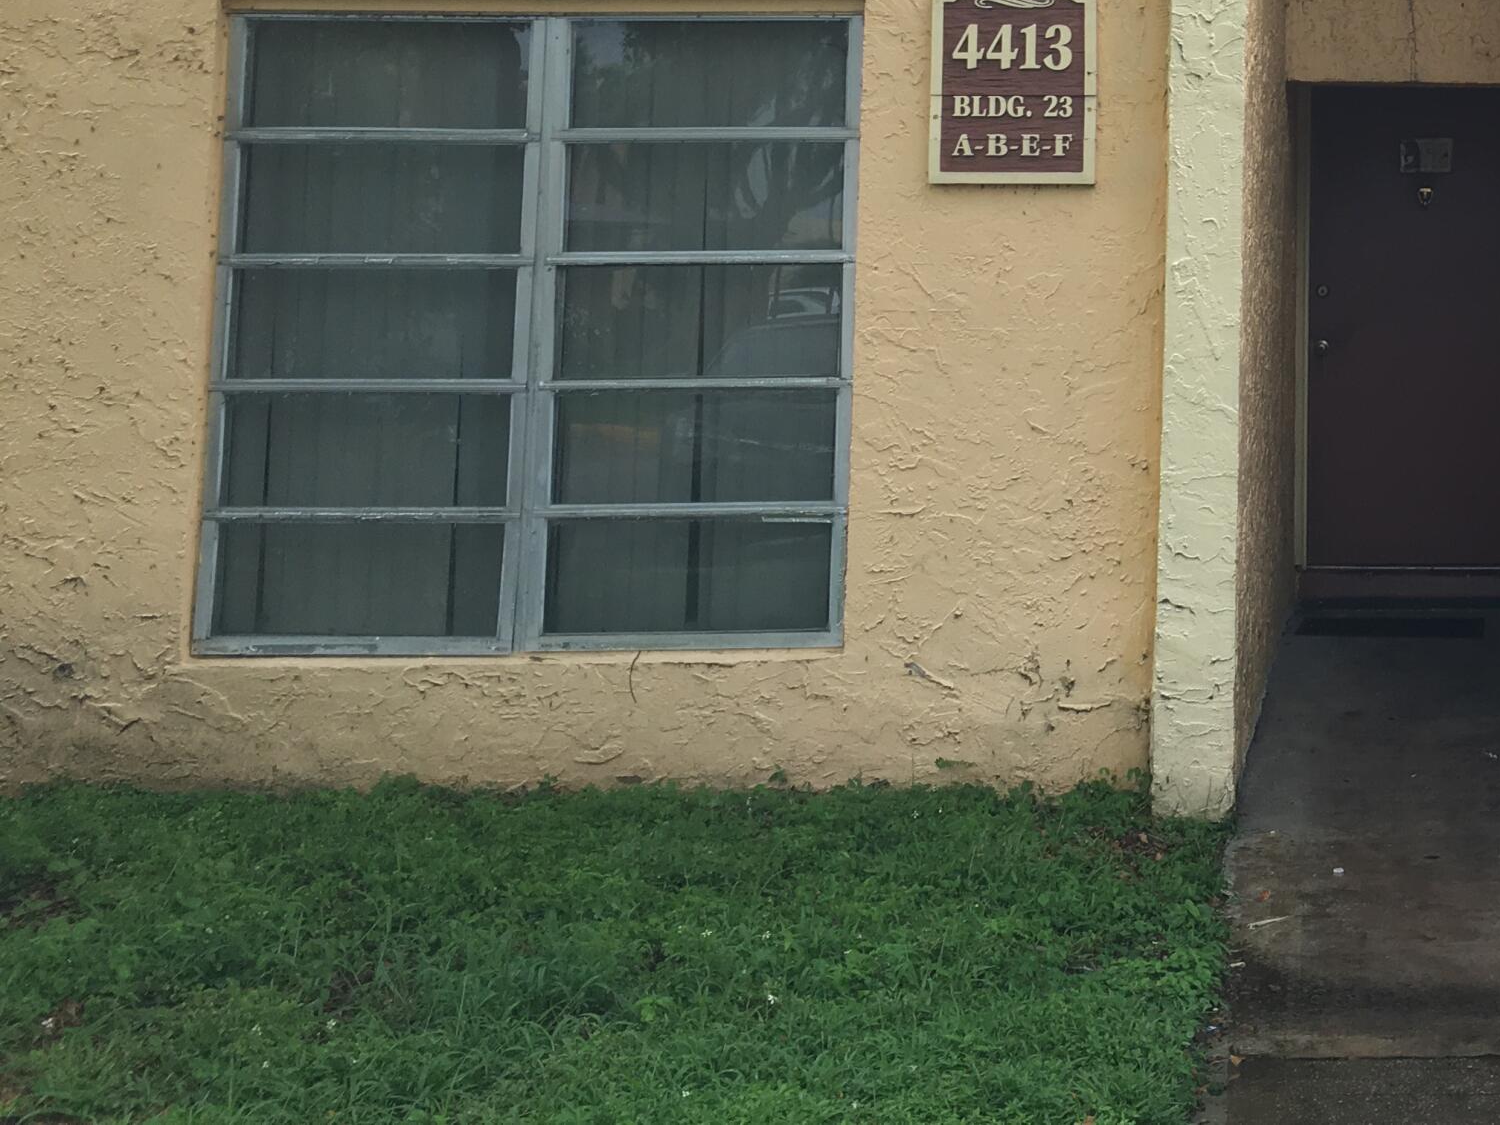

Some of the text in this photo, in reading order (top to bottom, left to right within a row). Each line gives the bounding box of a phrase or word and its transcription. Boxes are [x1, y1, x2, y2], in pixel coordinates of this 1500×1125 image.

[952, 23, 1073, 71] 4413
[952, 95, 1073, 117] BLDG. 23
[952, 133, 1073, 156] A-B-E-F
